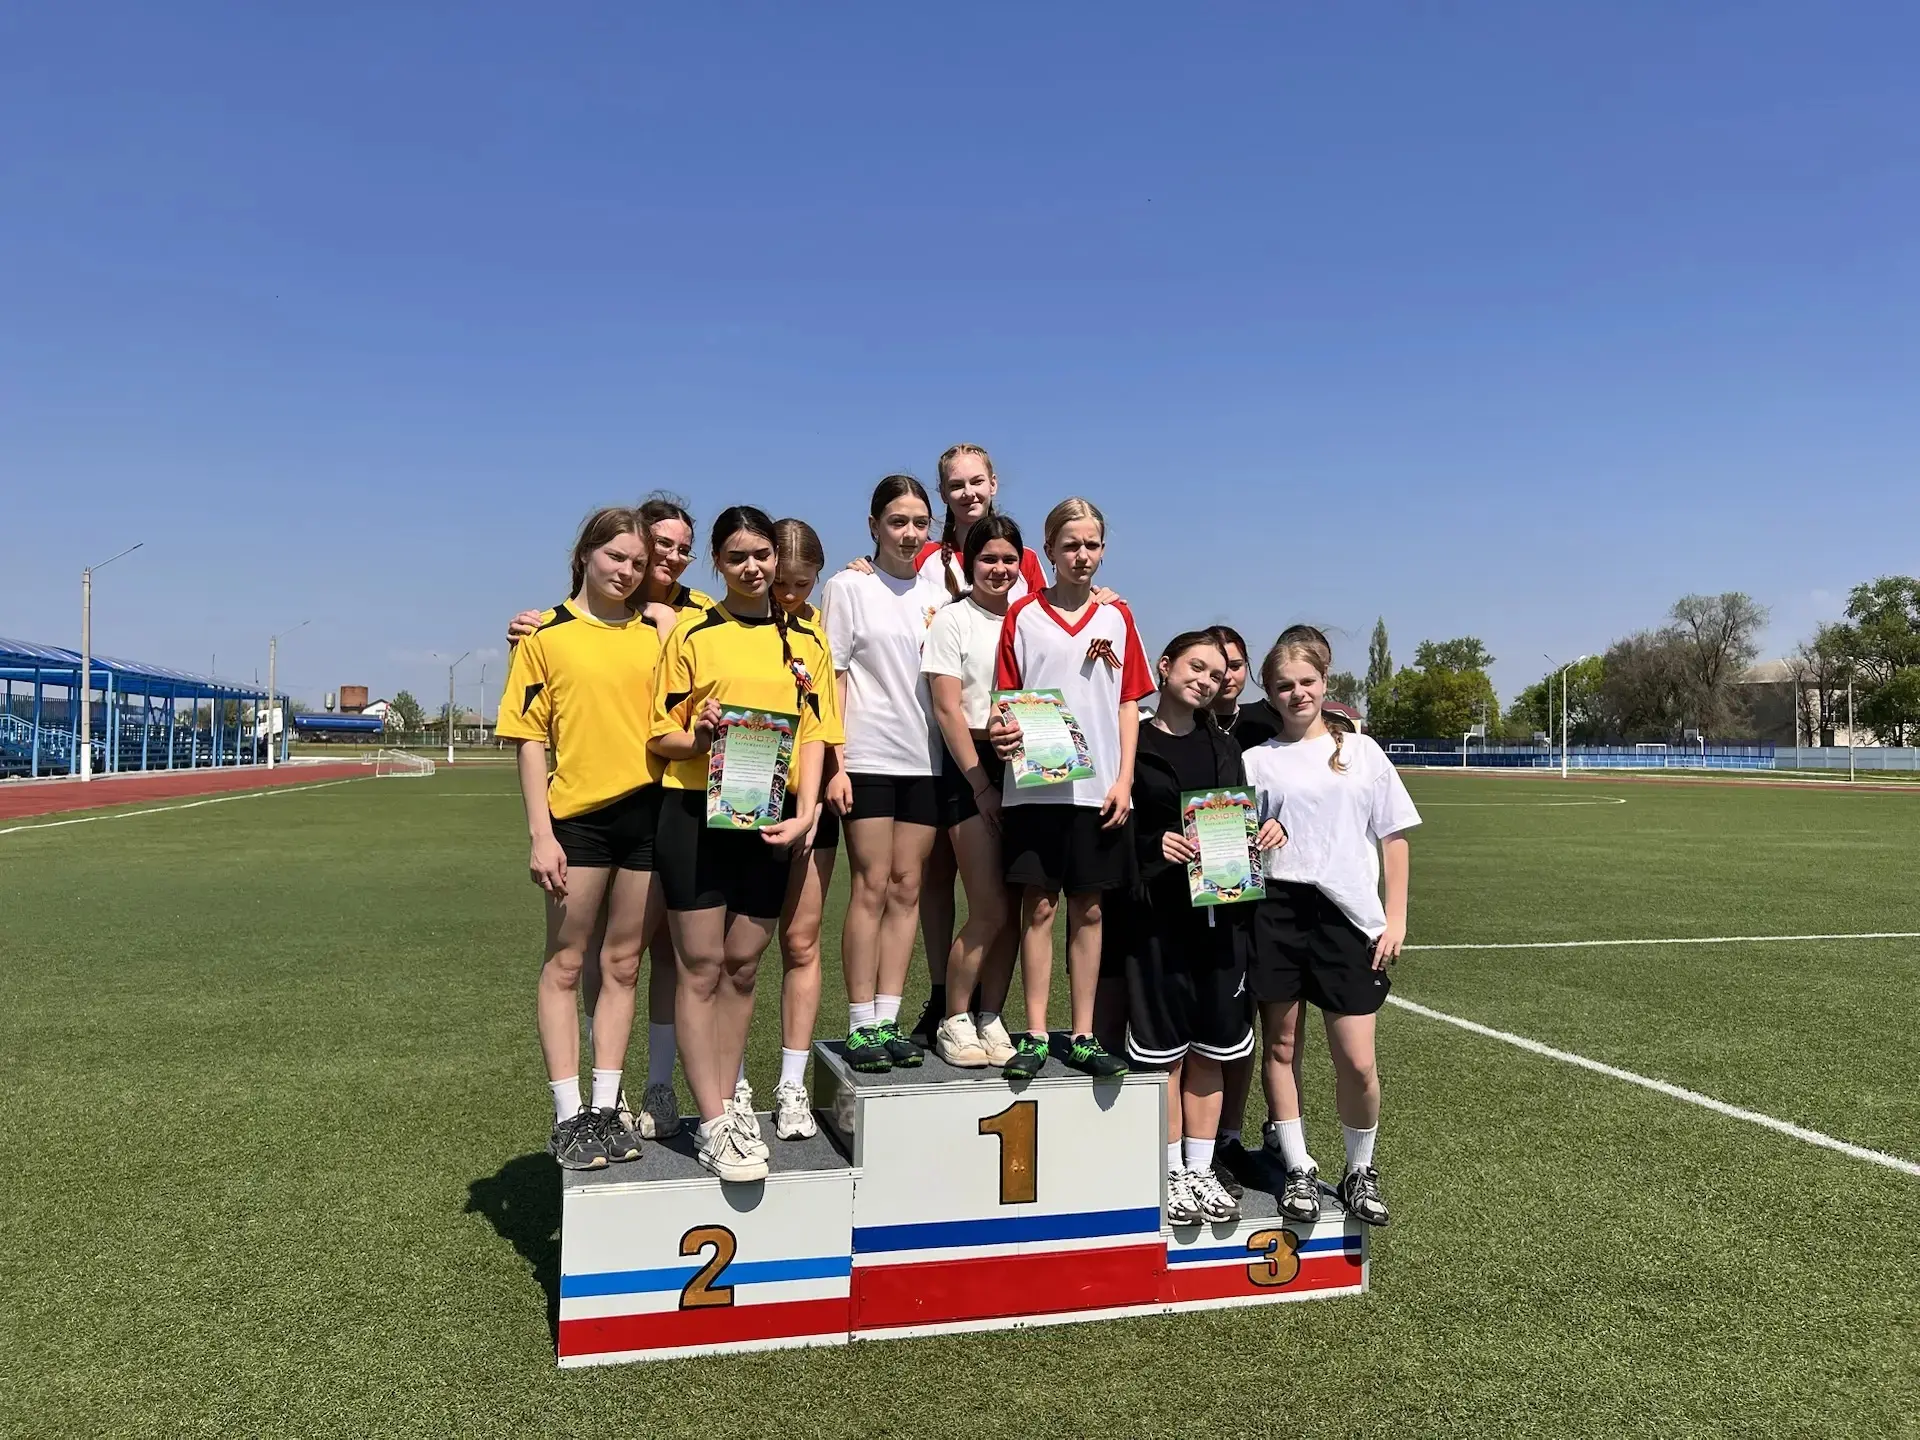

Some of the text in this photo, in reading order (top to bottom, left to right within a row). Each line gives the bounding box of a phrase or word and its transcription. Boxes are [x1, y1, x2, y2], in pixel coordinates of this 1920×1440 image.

[729, 732, 778, 744] ГРАМОТА
[978, 1100, 1038, 1205] 1
[679, 1224, 737, 1310] 2
[1247, 1228, 1300, 1287] 3
